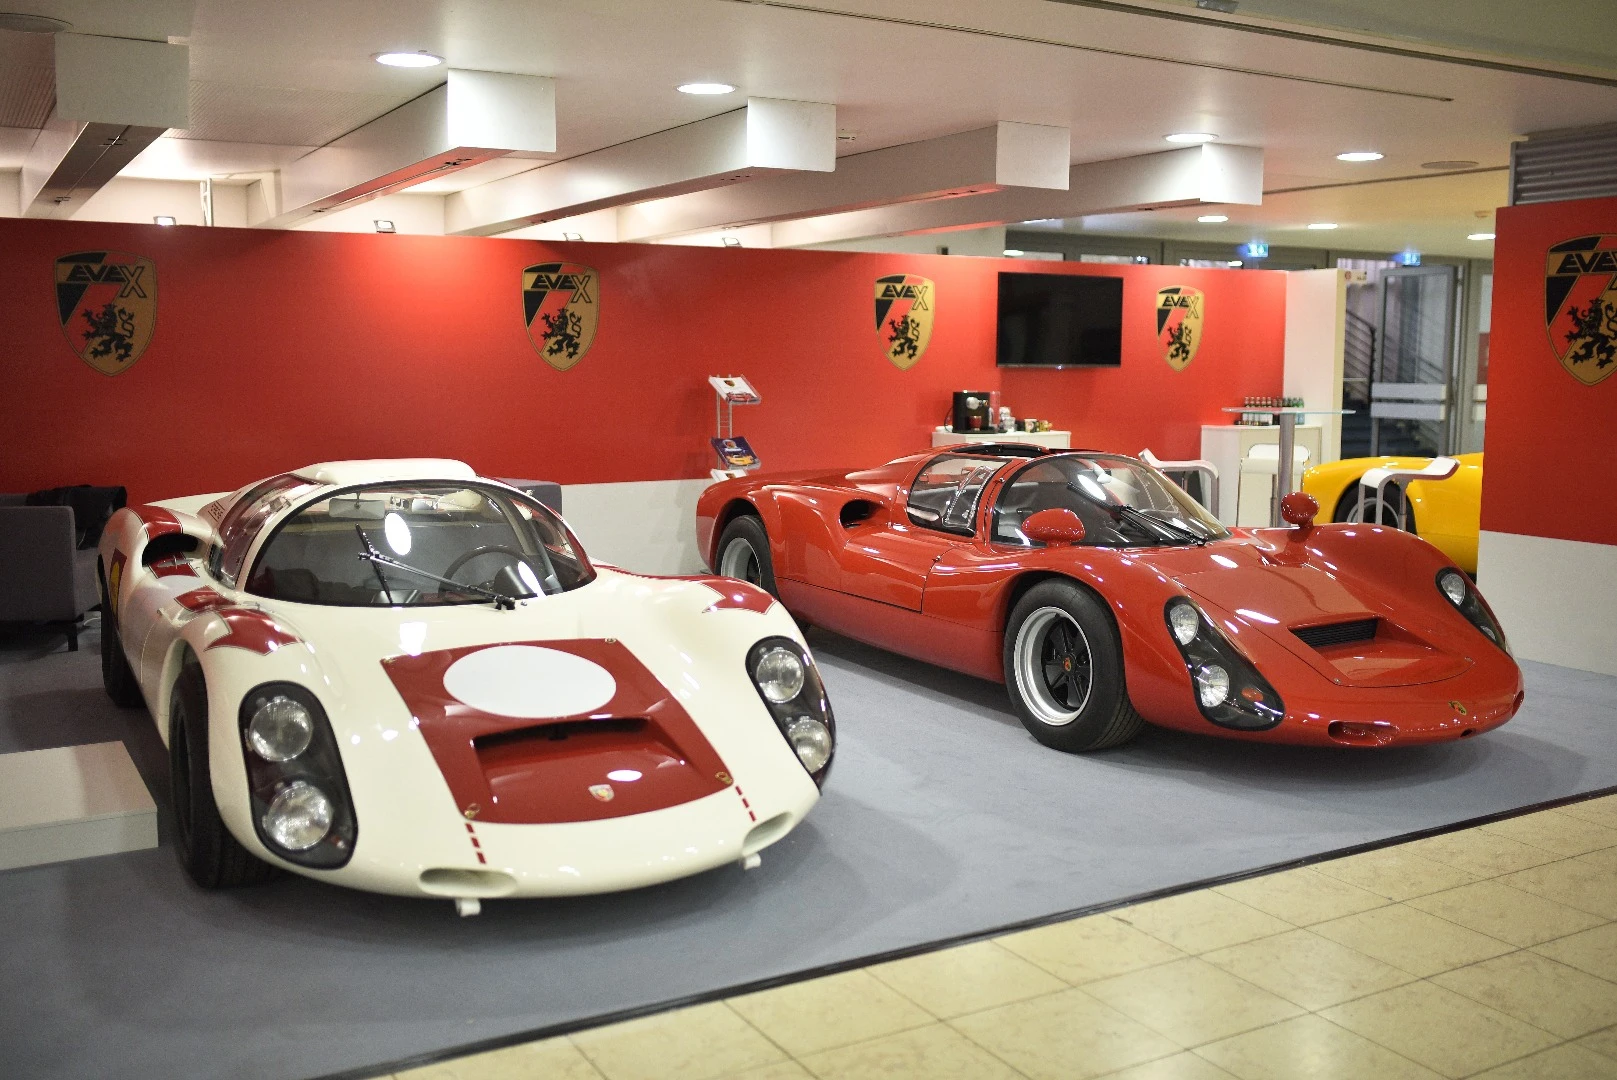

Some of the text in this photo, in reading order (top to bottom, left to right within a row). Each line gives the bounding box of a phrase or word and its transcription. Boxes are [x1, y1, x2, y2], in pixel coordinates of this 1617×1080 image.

[65, 264, 147, 298] EVEX
[531, 274, 592, 303] EVEX
[881, 284, 928, 311] EVEX
[1162, 295, 1199, 319] EVEX
